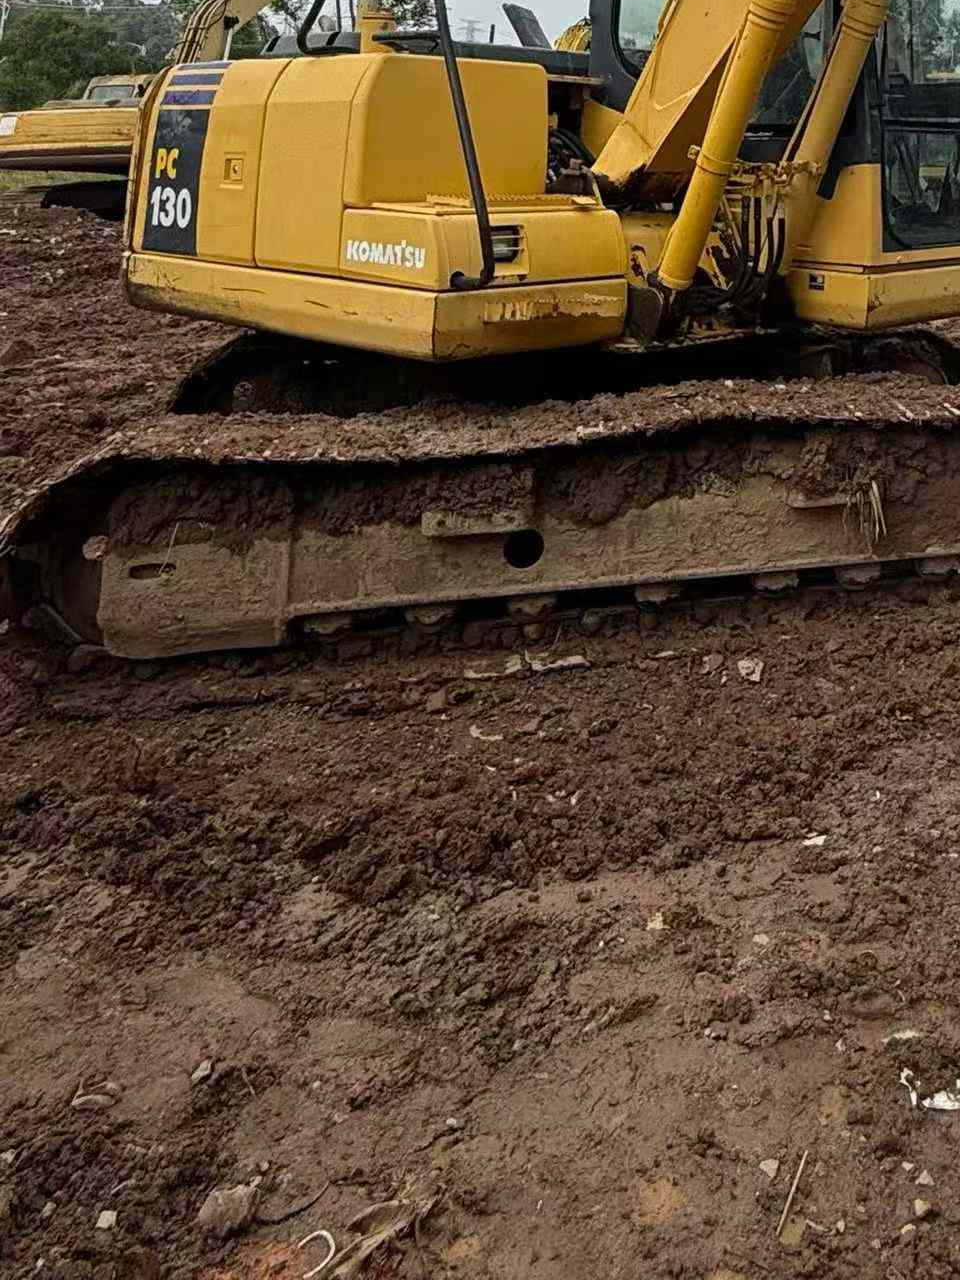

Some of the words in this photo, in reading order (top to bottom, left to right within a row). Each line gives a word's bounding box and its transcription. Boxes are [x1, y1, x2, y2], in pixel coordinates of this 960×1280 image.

[155, 147, 179, 180] PC
[150, 185, 192, 229] 130
[345, 239, 426, 269] KOMATSU
